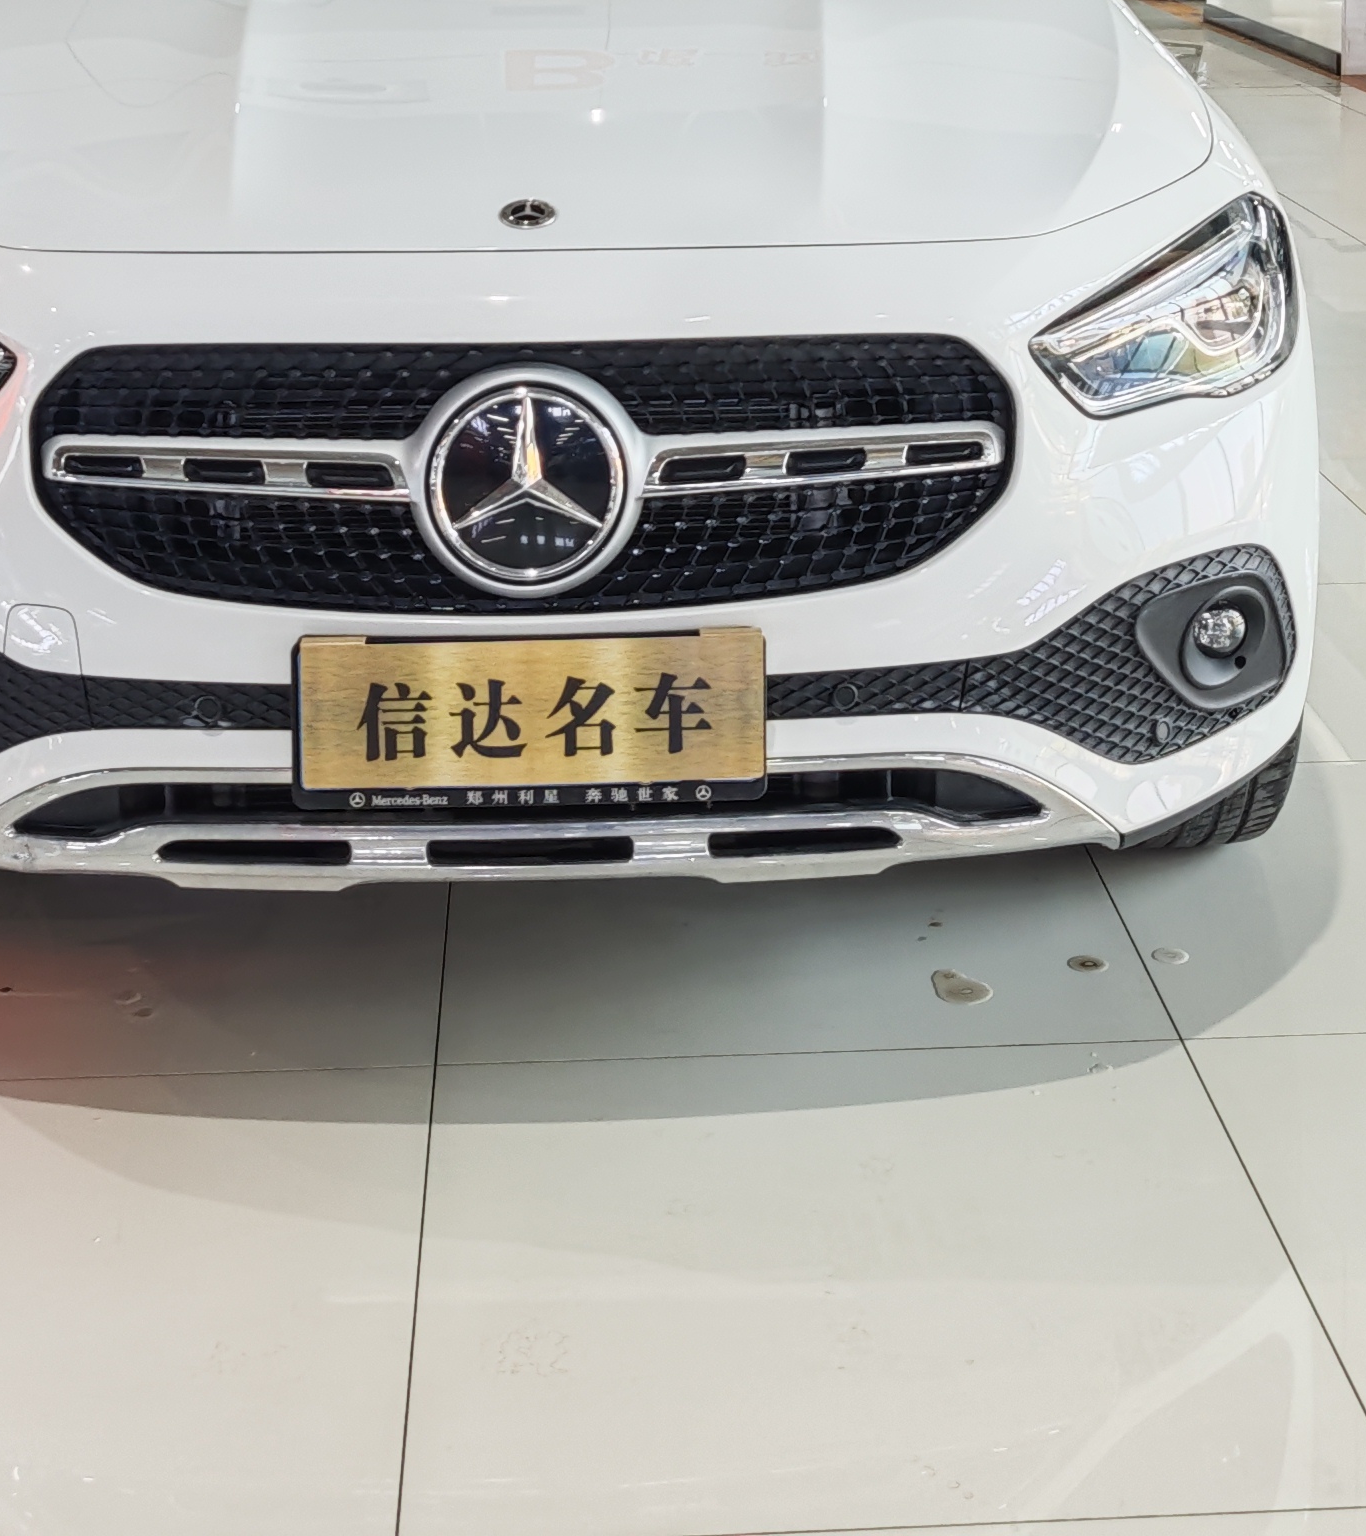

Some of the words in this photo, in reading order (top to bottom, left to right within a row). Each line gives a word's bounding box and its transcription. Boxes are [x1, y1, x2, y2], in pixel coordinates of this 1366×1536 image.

[356, 671, 712, 762] 信达名车
[372, 793, 448, 806] Mercedes-Benz
[466, 790, 560, 806] 郑州利星
[585, 787, 679, 803] 奔驰世家
